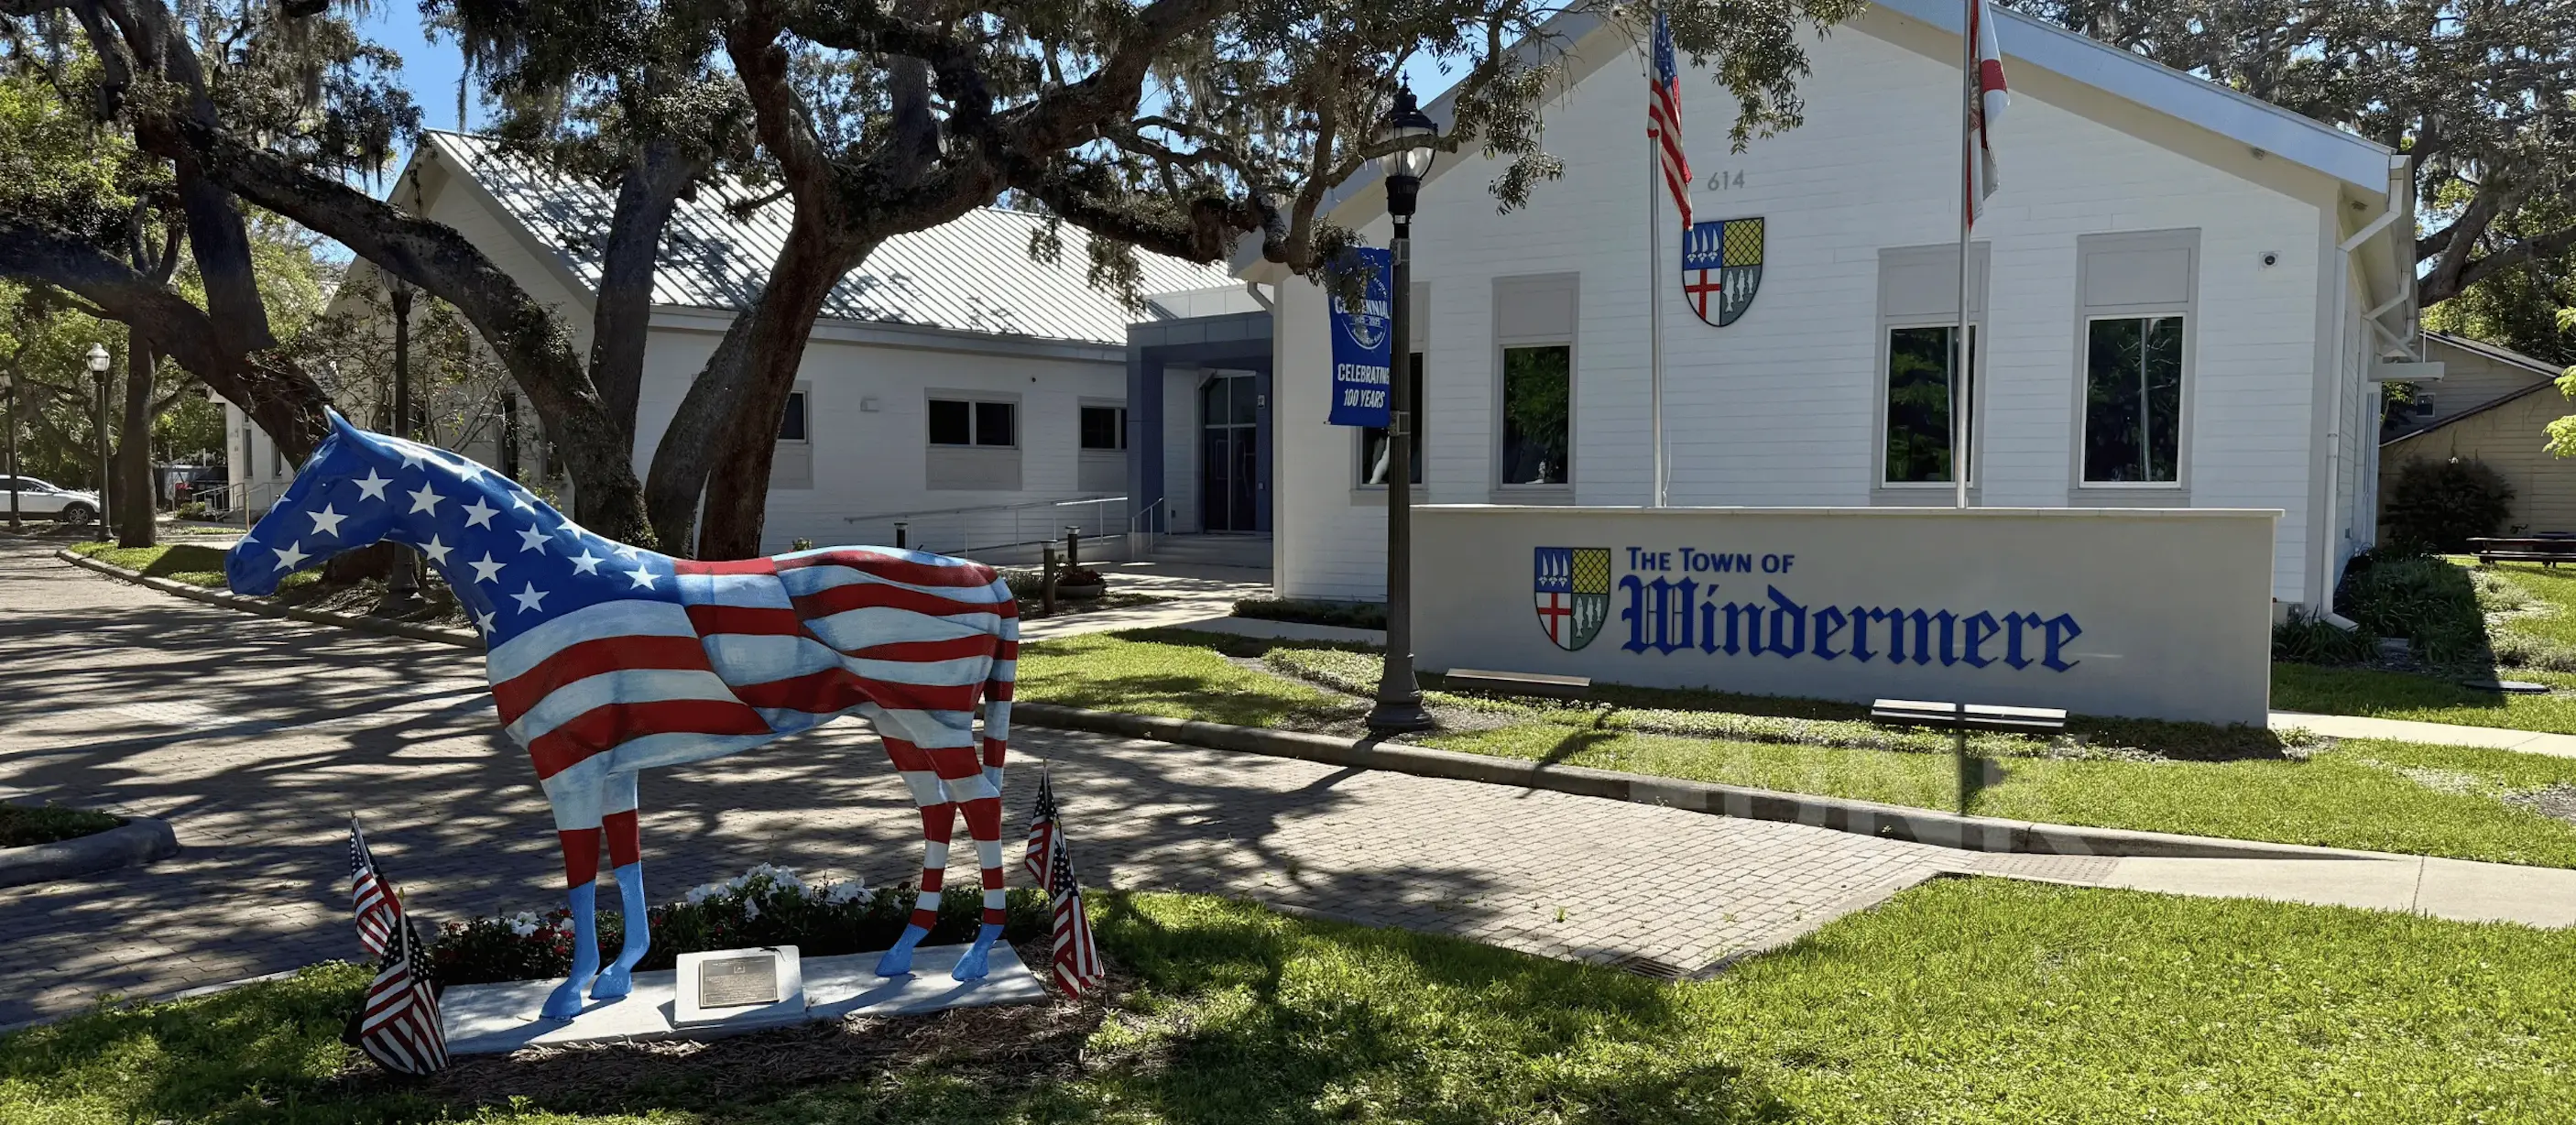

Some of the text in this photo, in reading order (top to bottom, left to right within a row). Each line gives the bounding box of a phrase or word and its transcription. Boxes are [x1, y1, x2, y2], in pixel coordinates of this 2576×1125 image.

[1707, 169, 1745, 191] 614
[1337, 363, 1390, 385] CELEBRATING
[1344, 388, 1386, 409] 100 YEARS
[1761, 553, 1796, 574] OF
[1618, 574, 2084, 672] Windermere
